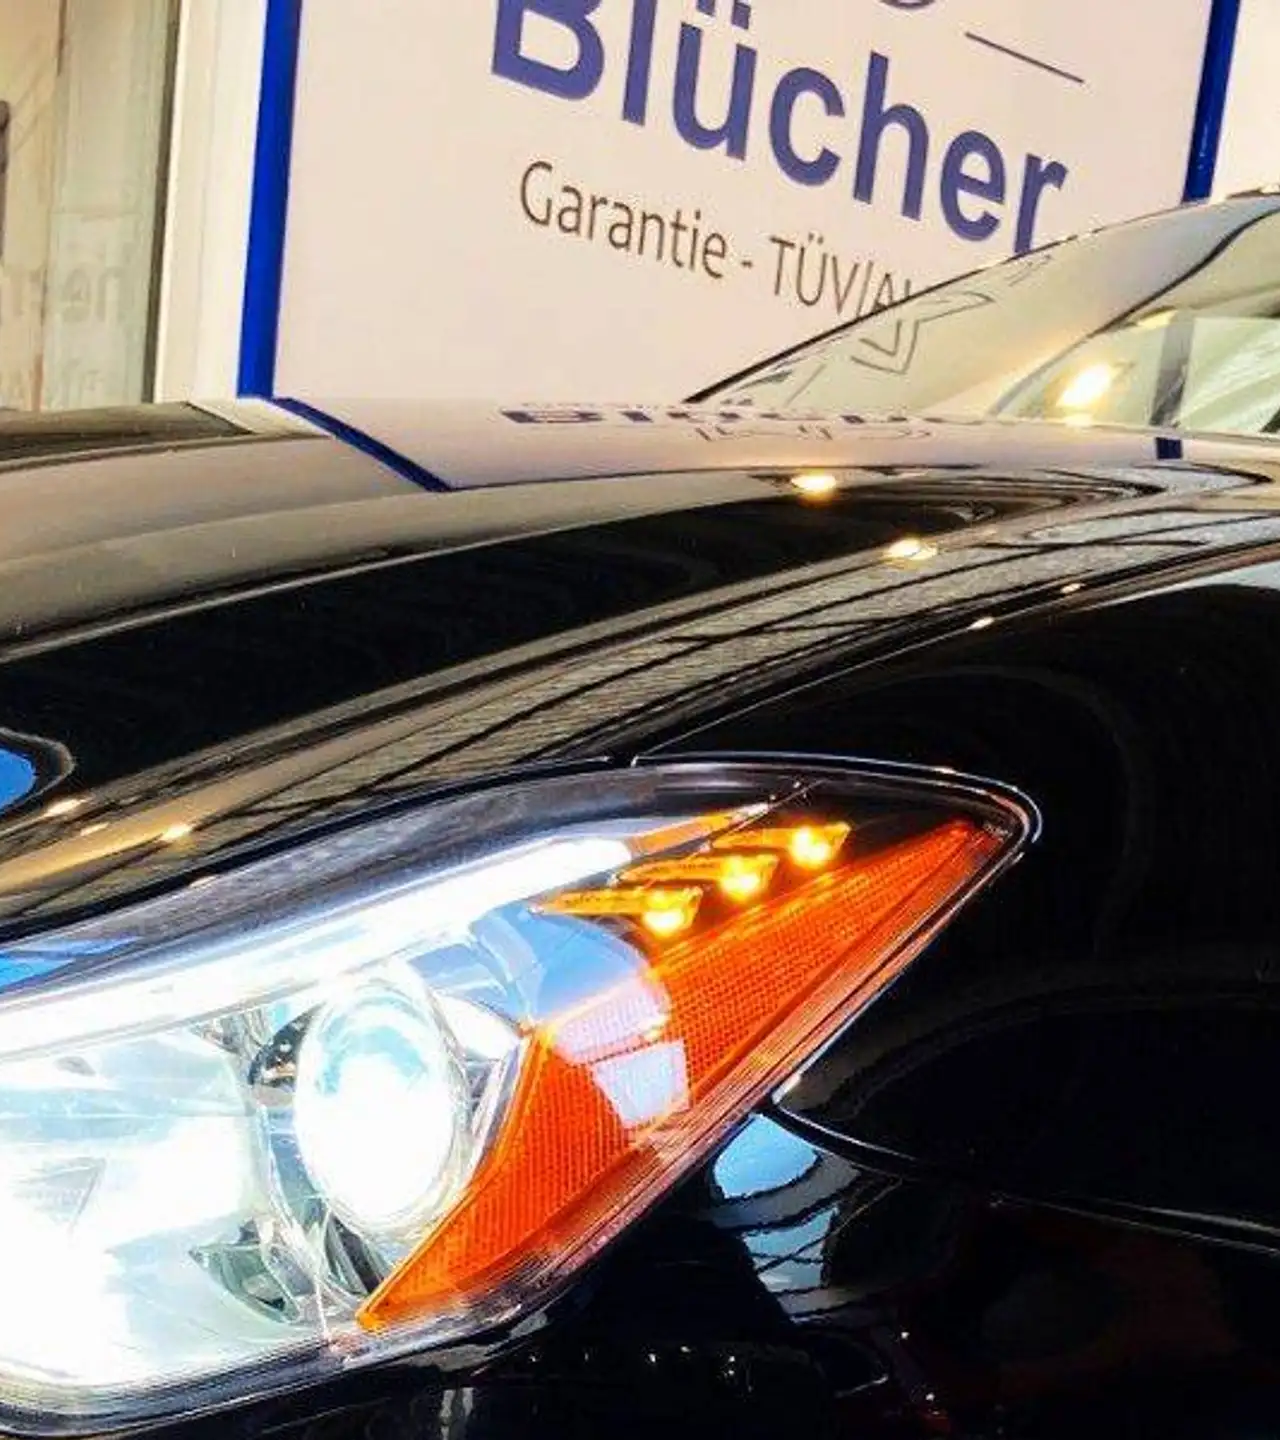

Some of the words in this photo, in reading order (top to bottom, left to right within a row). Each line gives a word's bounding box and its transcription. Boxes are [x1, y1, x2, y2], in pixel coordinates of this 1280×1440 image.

[491, 0, 1069, 255] Blücher
[520, 160, 727, 279] Garantie
[770, 233, 913, 318] TÜV/A
